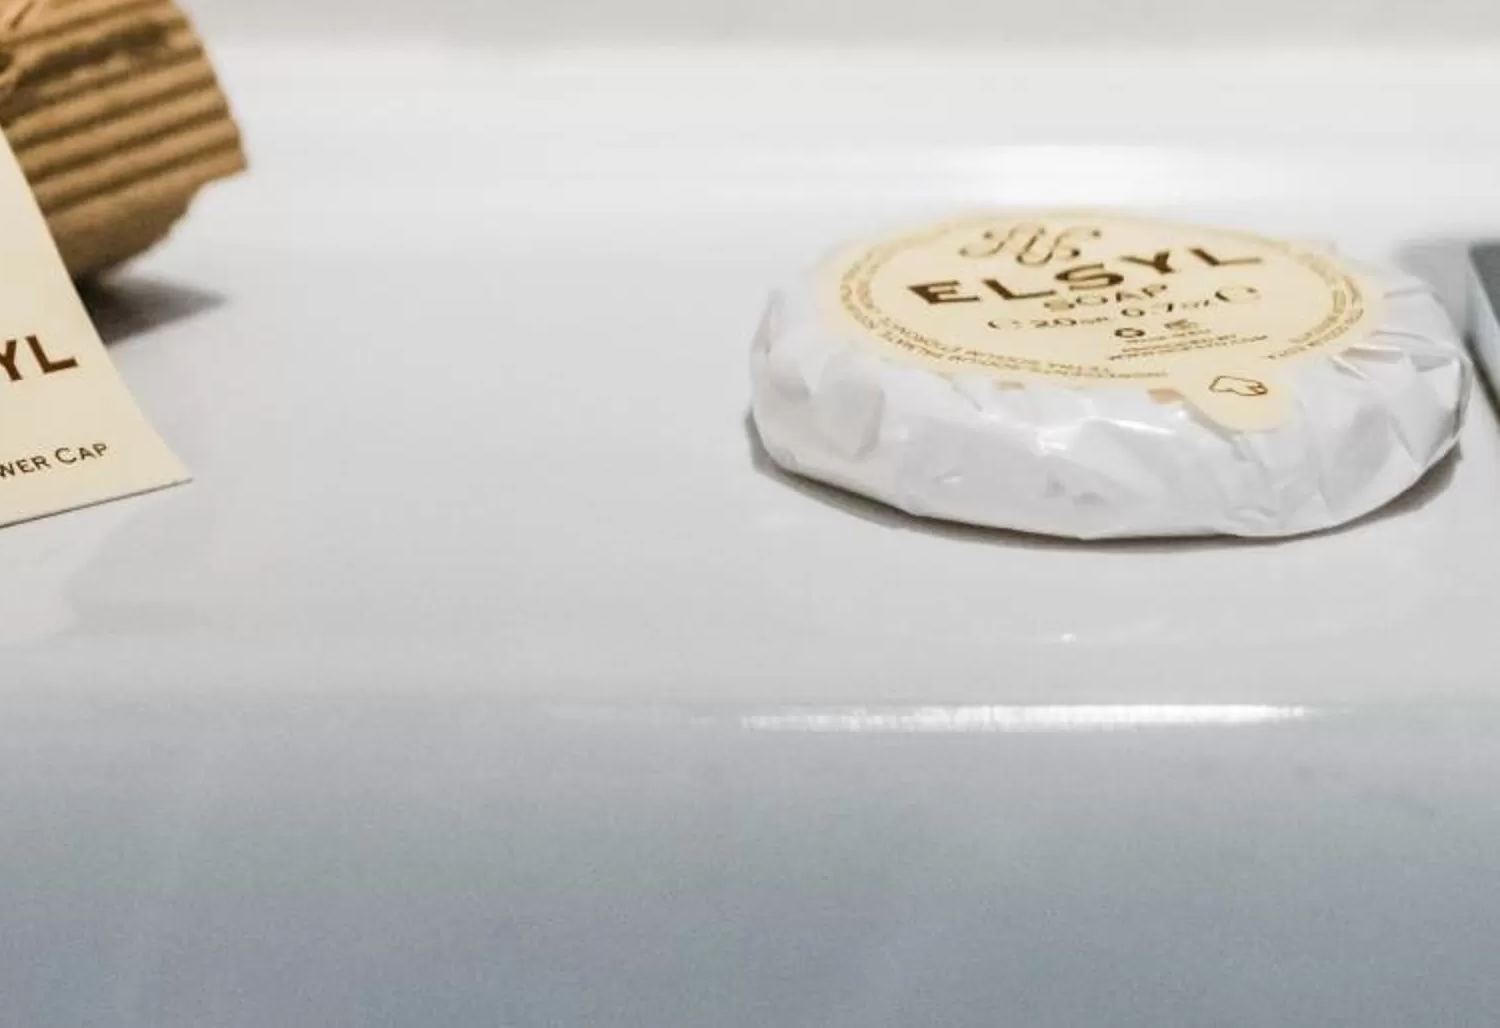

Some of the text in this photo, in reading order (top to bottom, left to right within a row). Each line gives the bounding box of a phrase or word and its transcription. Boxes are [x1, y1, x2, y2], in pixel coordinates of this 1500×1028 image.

[907, 247, 1263, 305] ELSYL
[1043, 283, 1169, 310] SOAP
[54, 442, 109, 465] CAP
